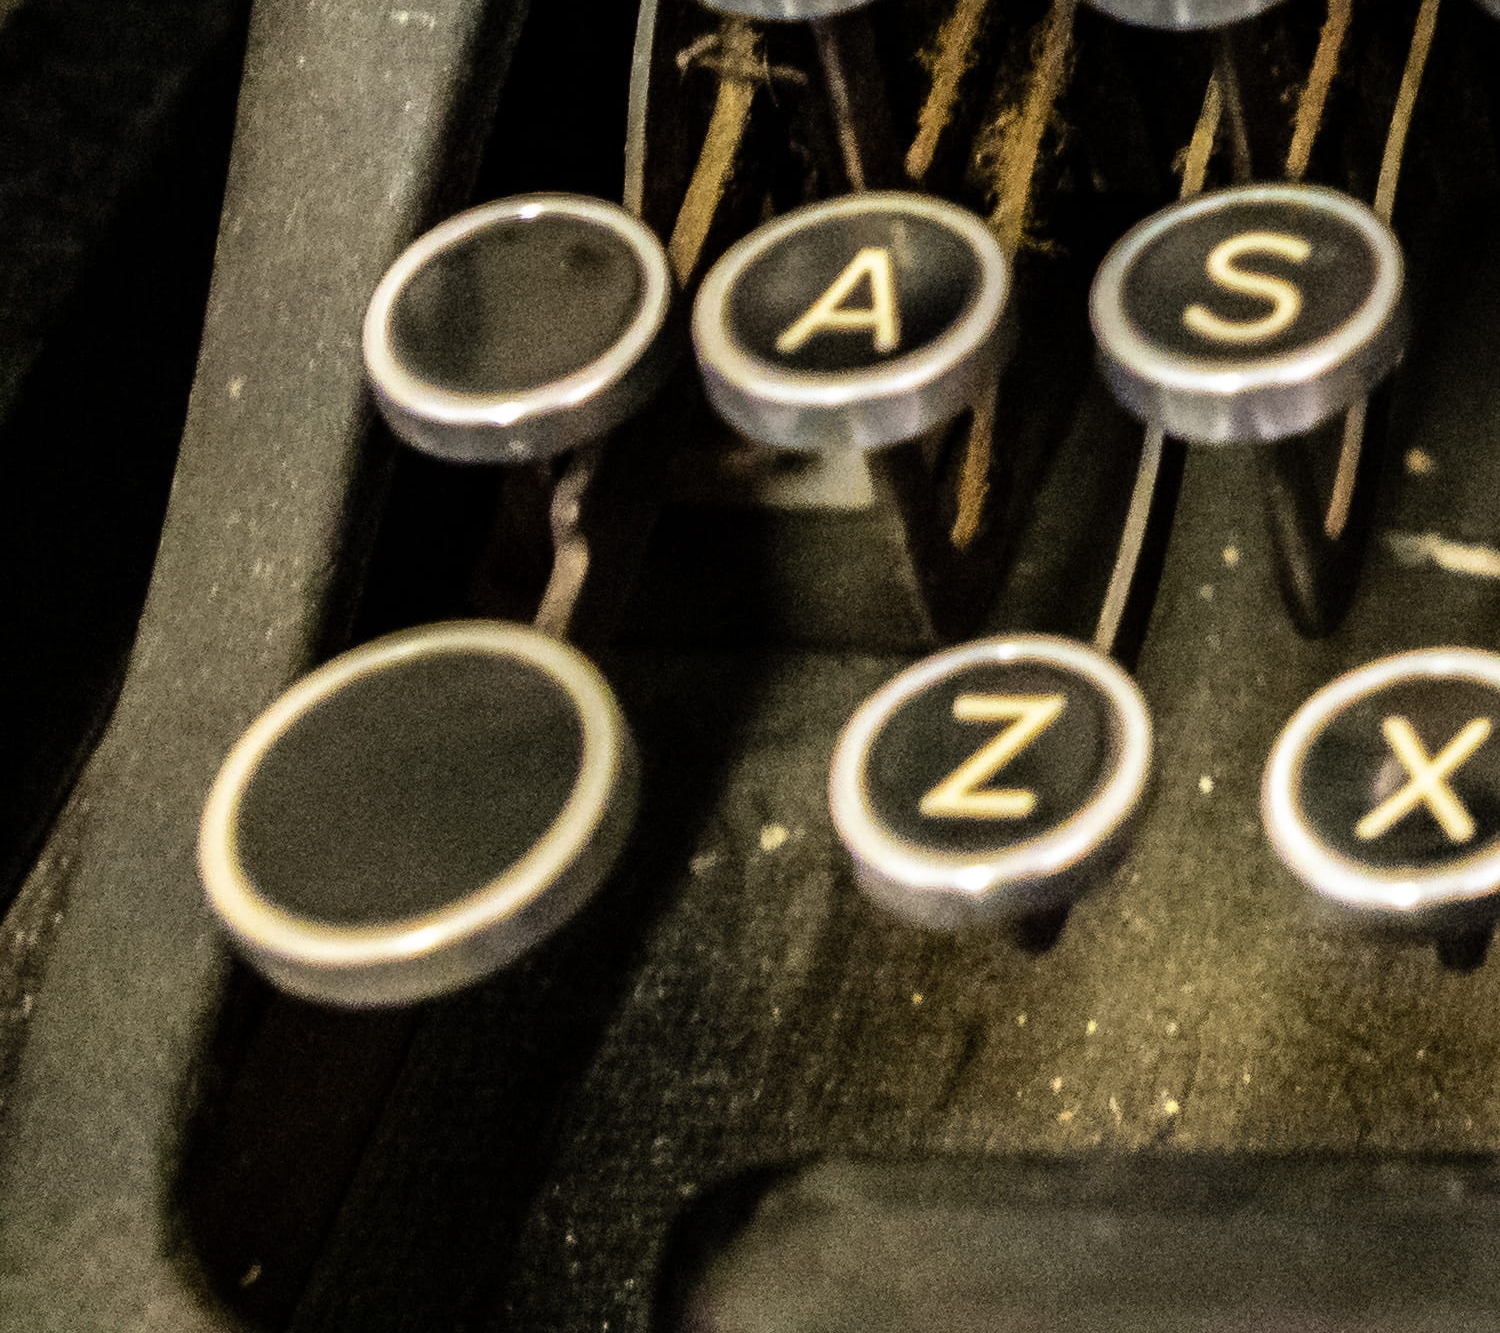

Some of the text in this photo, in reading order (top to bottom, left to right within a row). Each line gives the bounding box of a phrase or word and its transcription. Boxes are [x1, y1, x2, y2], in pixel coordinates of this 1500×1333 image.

[779, 246, 897, 349] A
[1184, 231, 1311, 342] S
[920, 693, 1066, 818] Z
[1356, 716, 1492, 841] X
